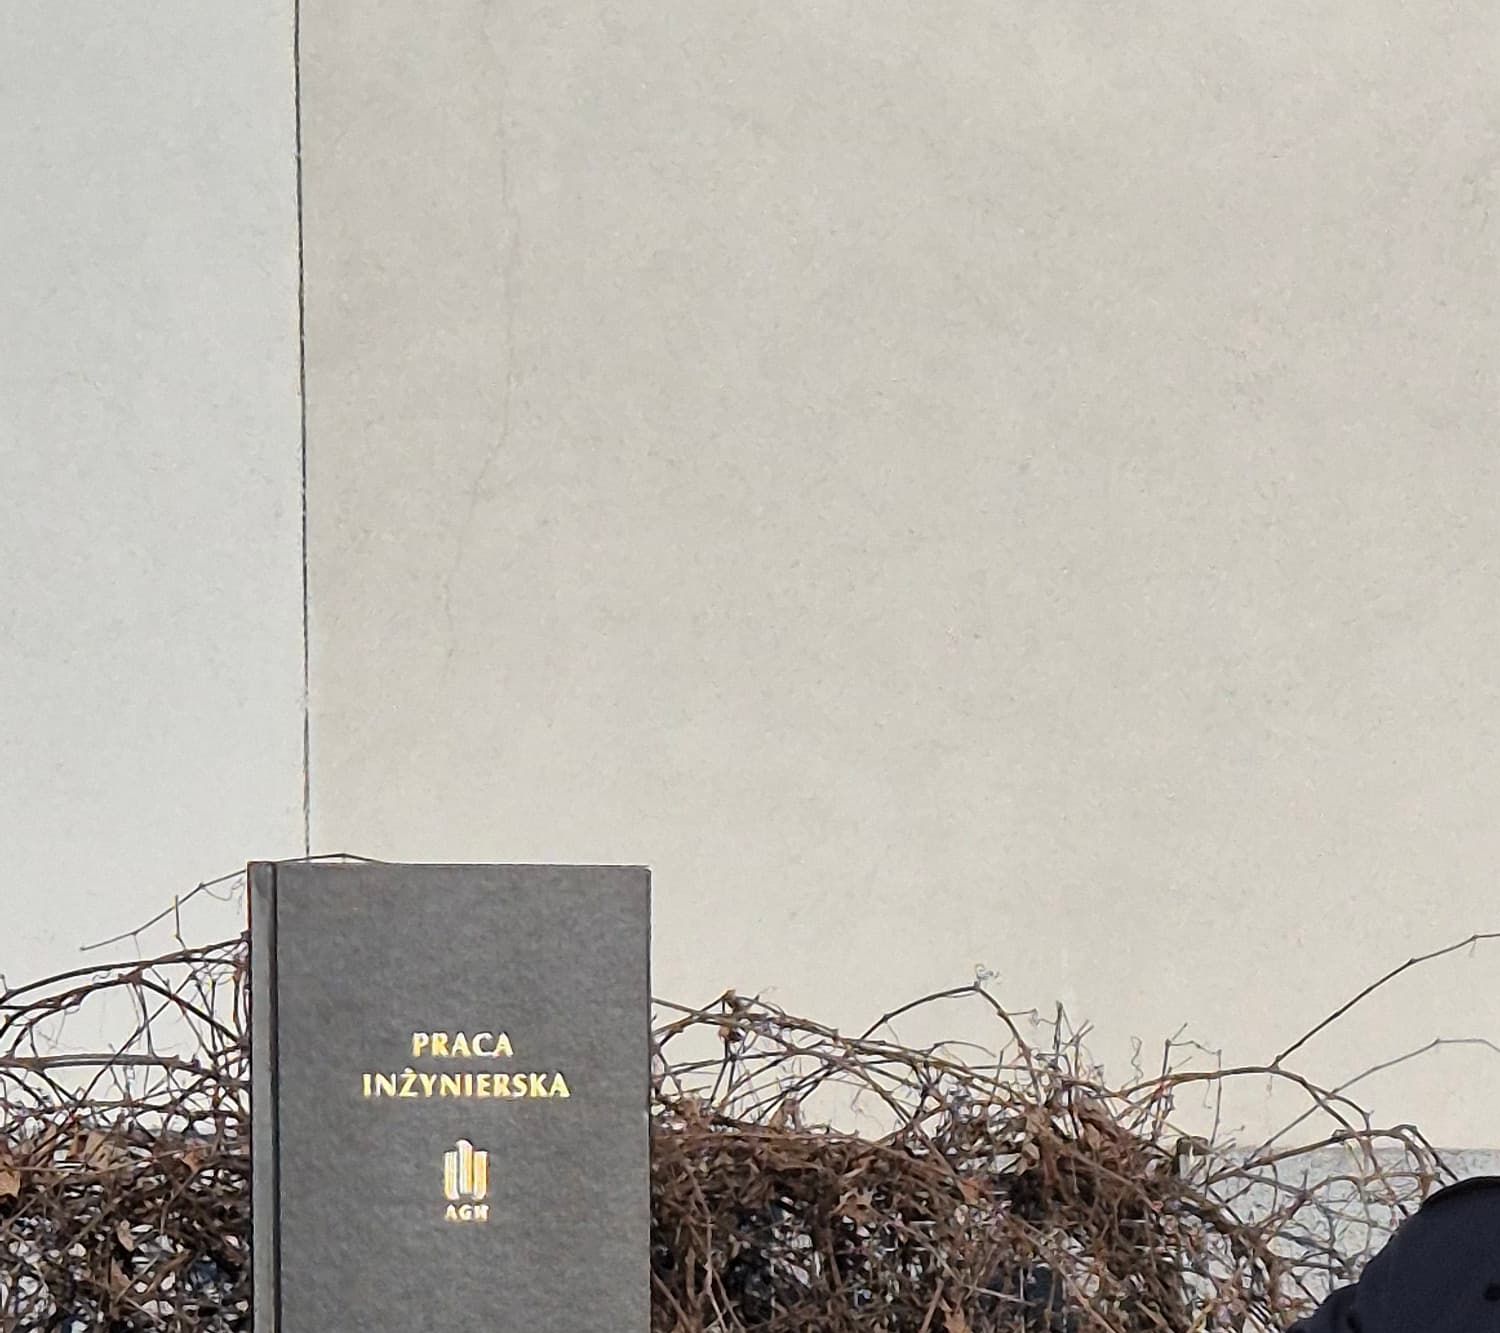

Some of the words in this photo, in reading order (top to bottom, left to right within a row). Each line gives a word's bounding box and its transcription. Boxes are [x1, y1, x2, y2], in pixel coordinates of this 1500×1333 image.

[411, 1031, 514, 1058] PRACA
[361, 1066, 571, 1099] INŻYNIERSKA
[444, 1203, 490, 1222] AGH
